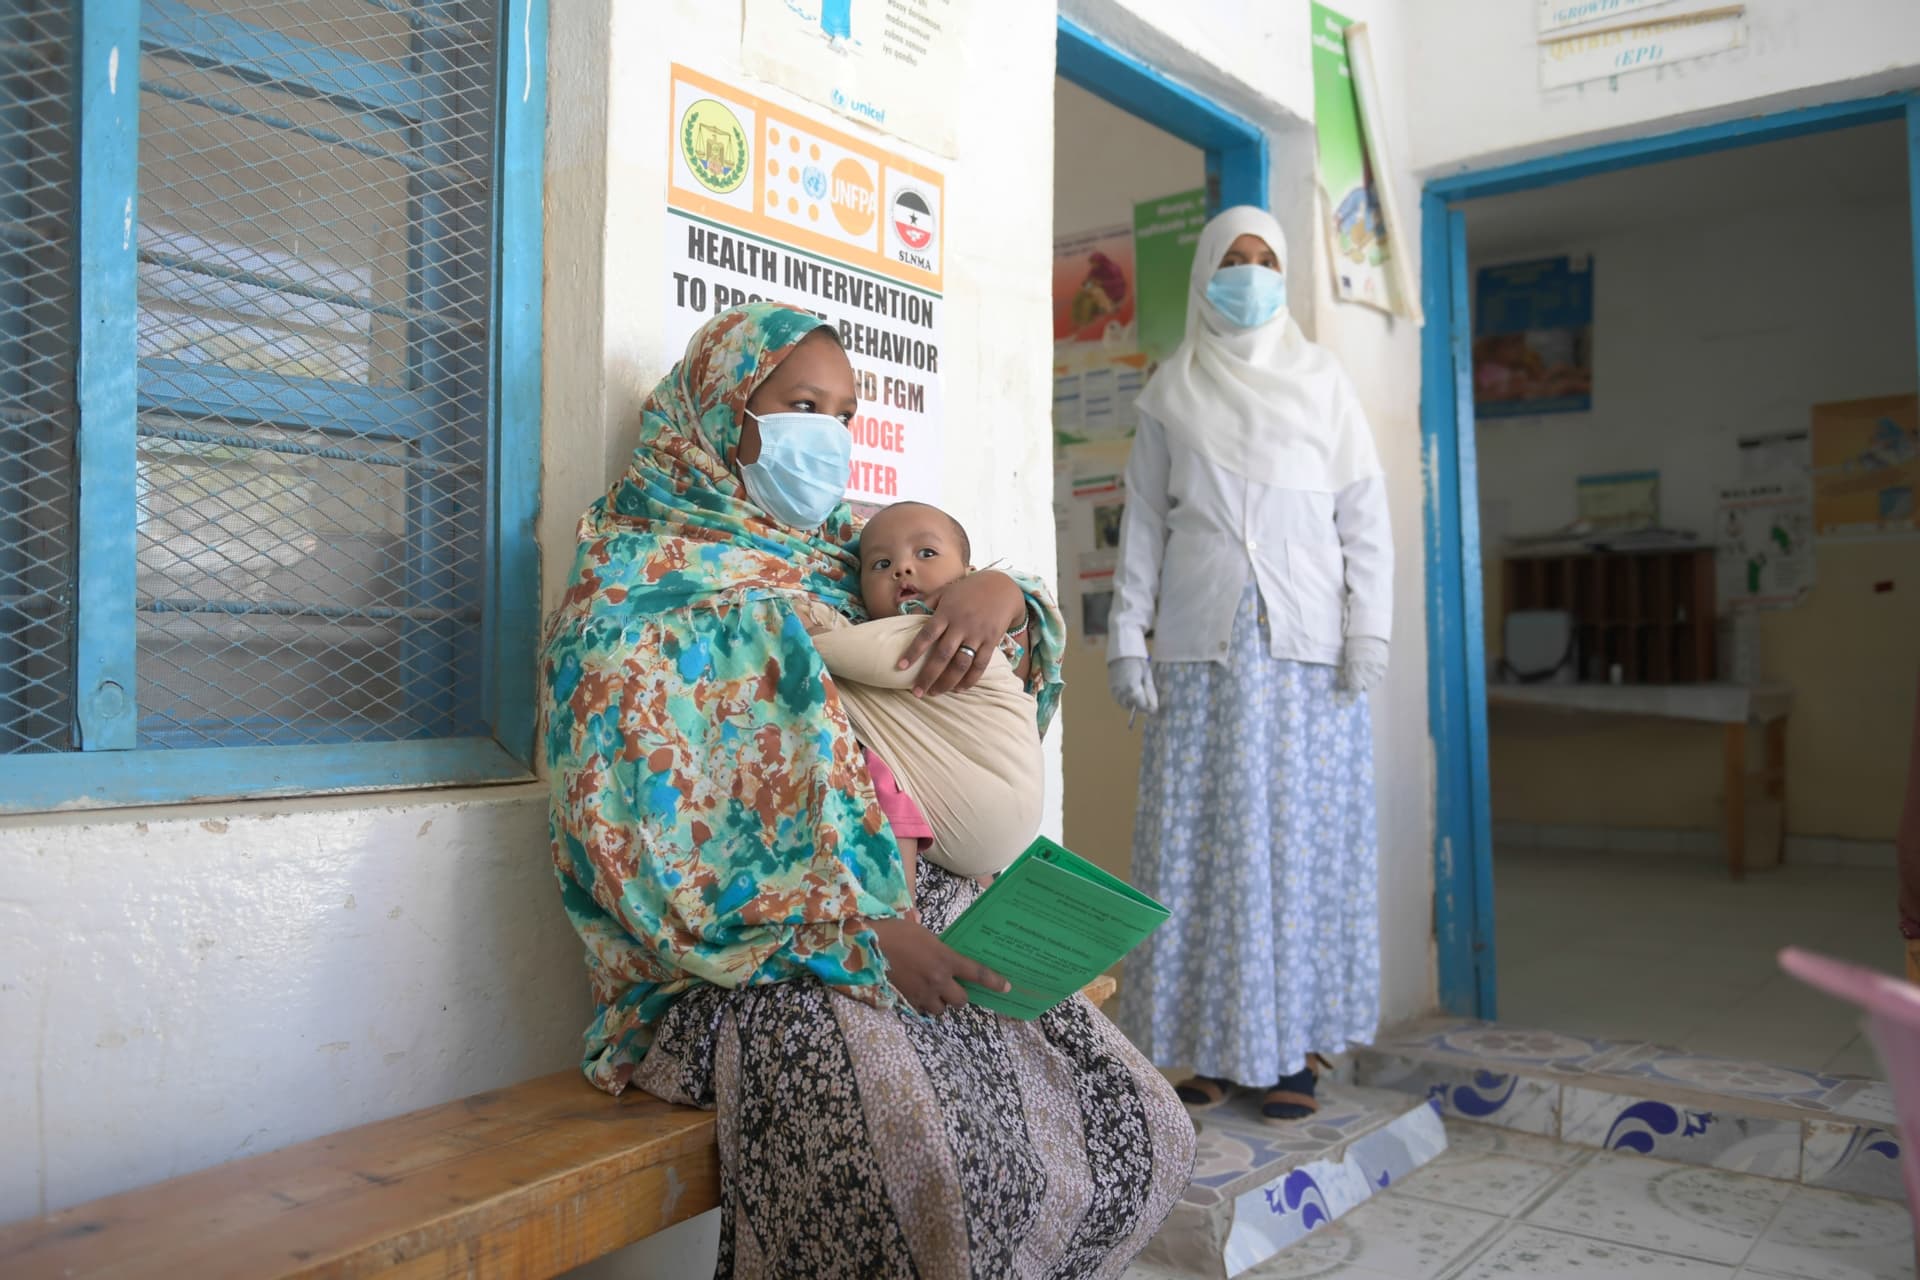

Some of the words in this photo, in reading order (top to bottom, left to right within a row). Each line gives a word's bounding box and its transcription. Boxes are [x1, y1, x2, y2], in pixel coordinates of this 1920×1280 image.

[1615, 43, 1664, 67] (EPI)
[831, 177, 878, 216] UNFPA
[688, 225, 777, 283] HEALTH
[784, 255, 934, 329] INTERVENTION
[898, 250, 932, 271] SLNMA
[673, 272, 707, 312] TO
[838, 318, 938, 374] BEHAVIOR
[883, 377, 925, 413] FGM
